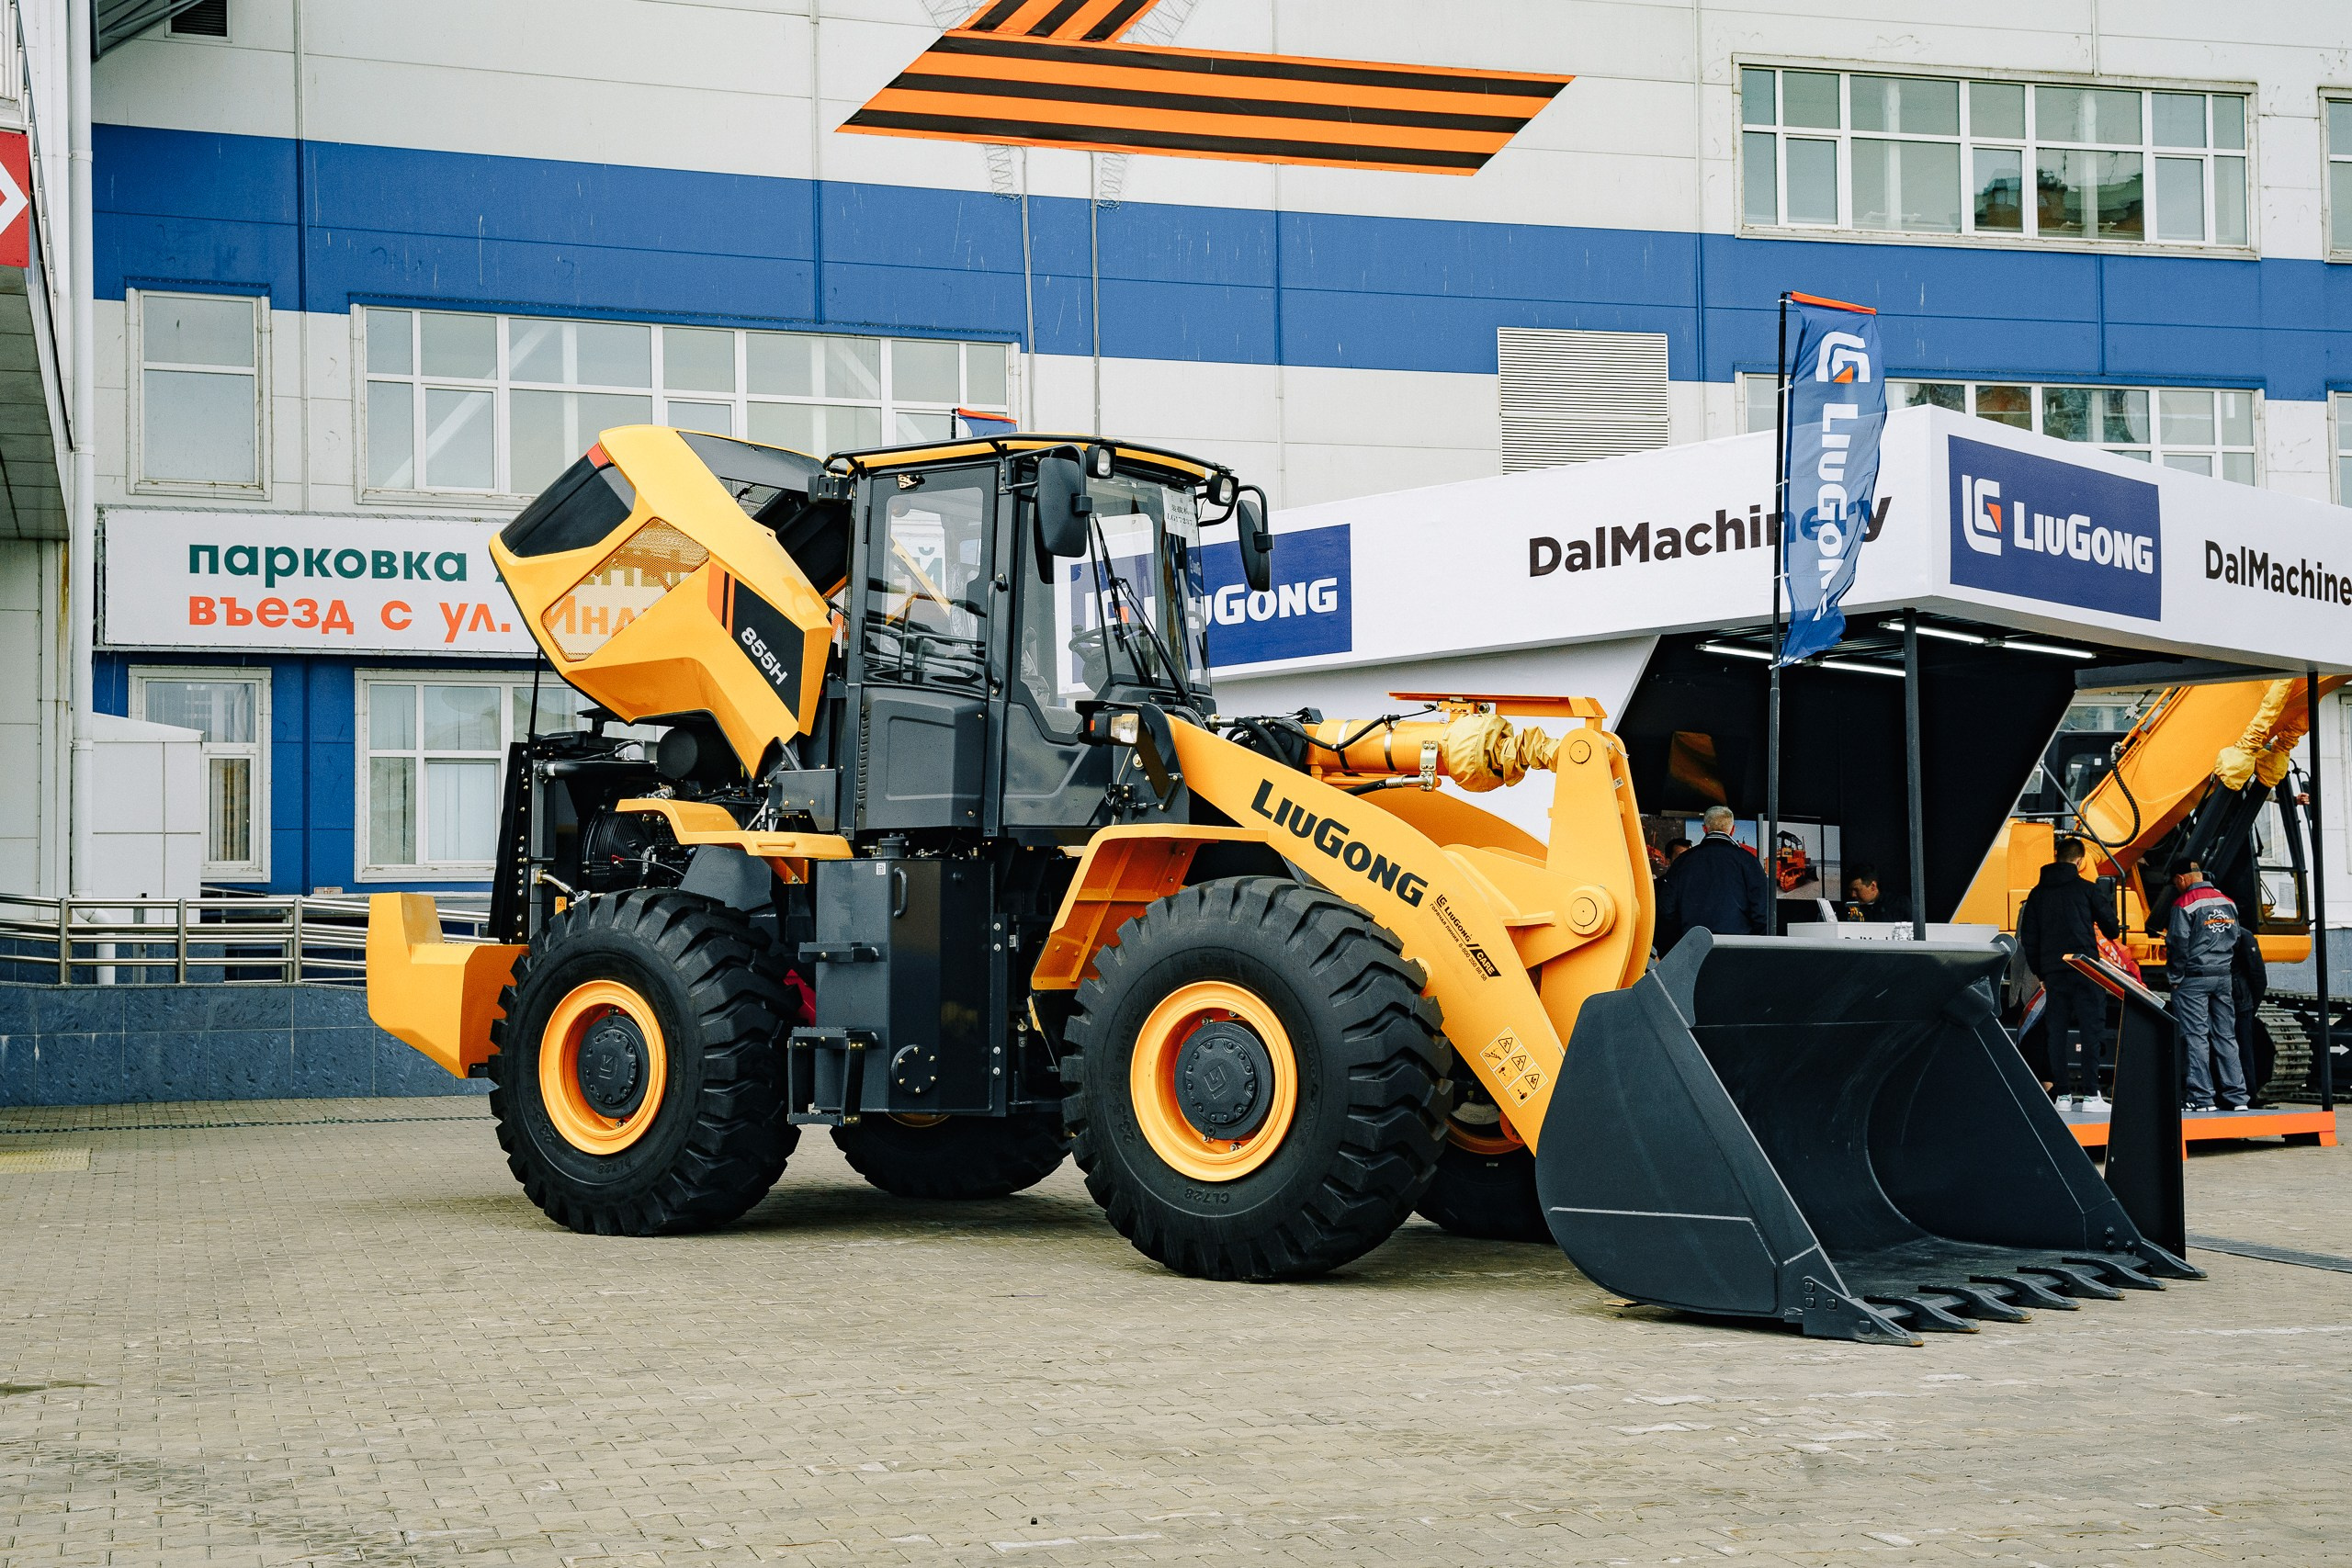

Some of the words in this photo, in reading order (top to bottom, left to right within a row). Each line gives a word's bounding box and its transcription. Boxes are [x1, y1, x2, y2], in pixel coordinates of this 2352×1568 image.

[188, 544, 468, 588] парковка
[188, 595, 355, 635] въезд
[380, 600, 413, 631] с
[438, 602, 511, 643] ул.
[741, 626, 788, 685] 855H
[1476, 952, 1496, 975] CARE
[1183, 1188, 1230, 1205] CL728
